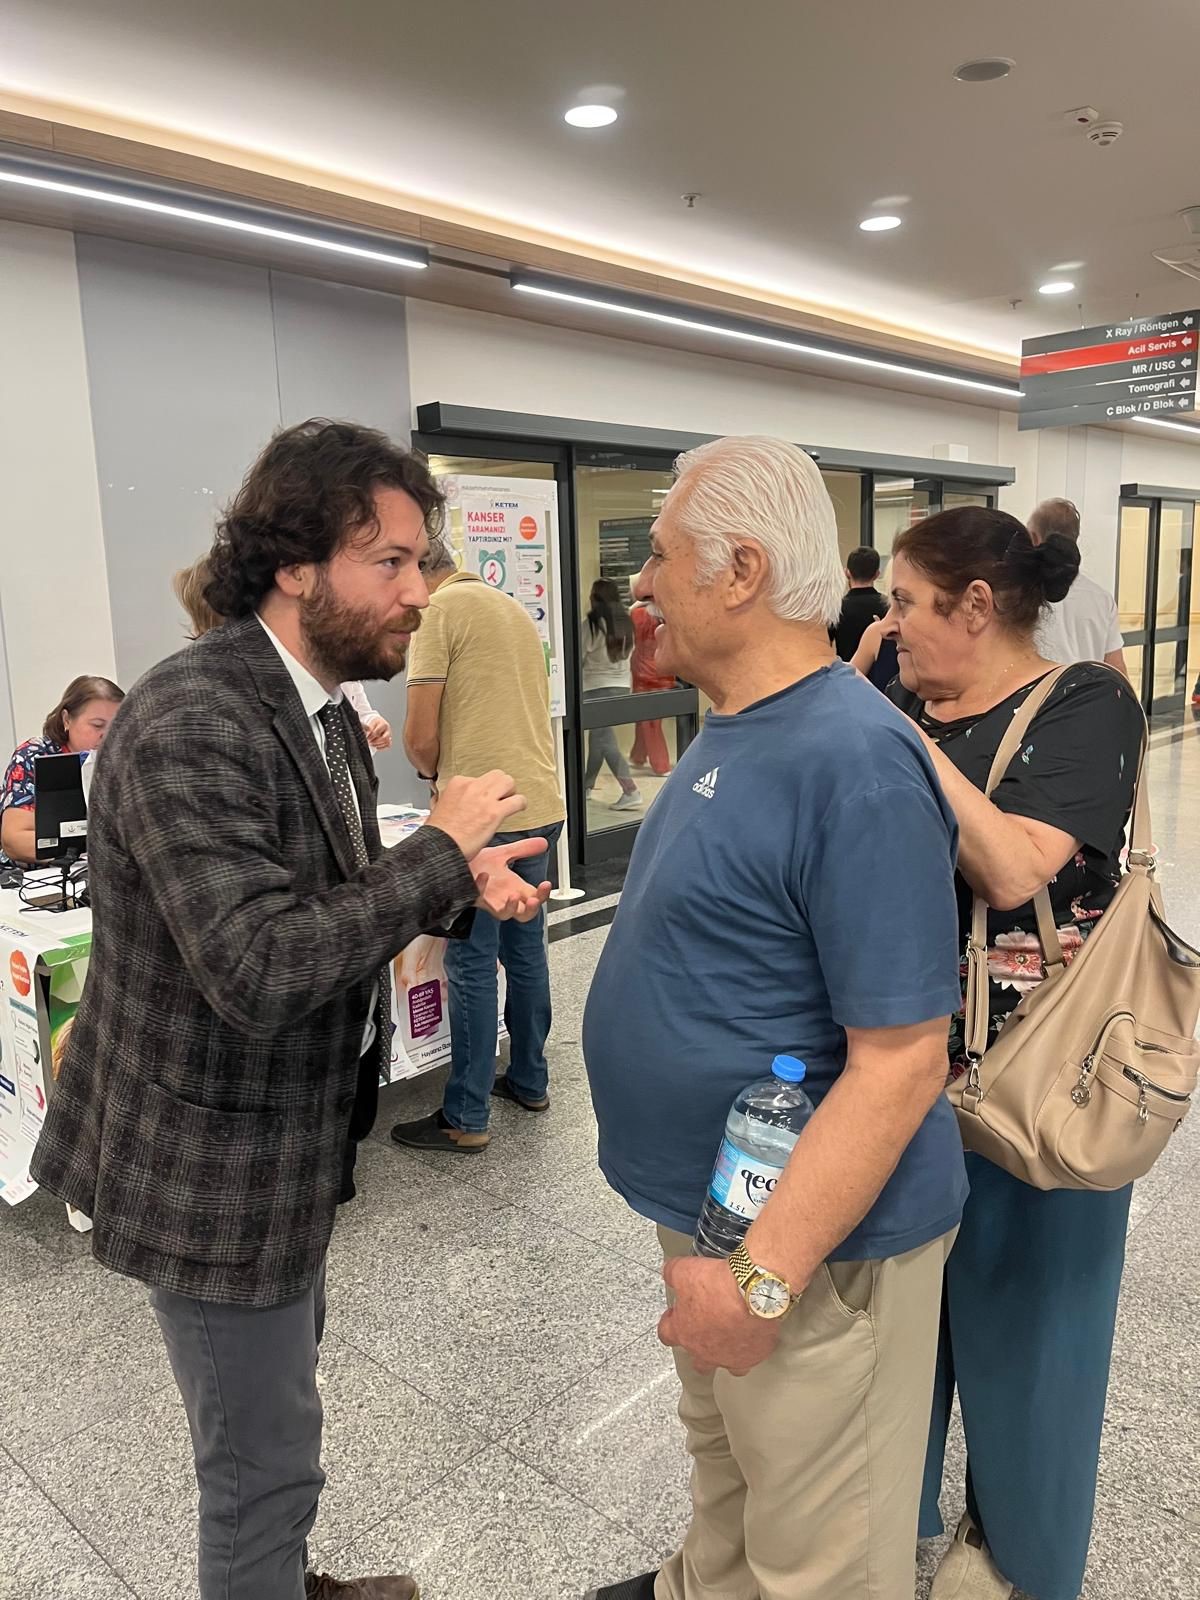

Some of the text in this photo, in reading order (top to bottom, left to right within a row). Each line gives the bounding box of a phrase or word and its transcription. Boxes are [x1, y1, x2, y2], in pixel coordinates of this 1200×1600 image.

[1105, 320, 1179, 338] X Ray / Röntgen
[1127, 340, 1177, 355] Acil Servis
[1132, 360, 1176, 374] MR / USG
[1128, 379, 1175, 393] Tomografi
[1106, 399, 1174, 415] C Blok / D Blok
[467, 511, 505, 522] KANSER
[467, 525, 506, 533] TARAMANIZI
[692, 782, 715, 798] adidas
